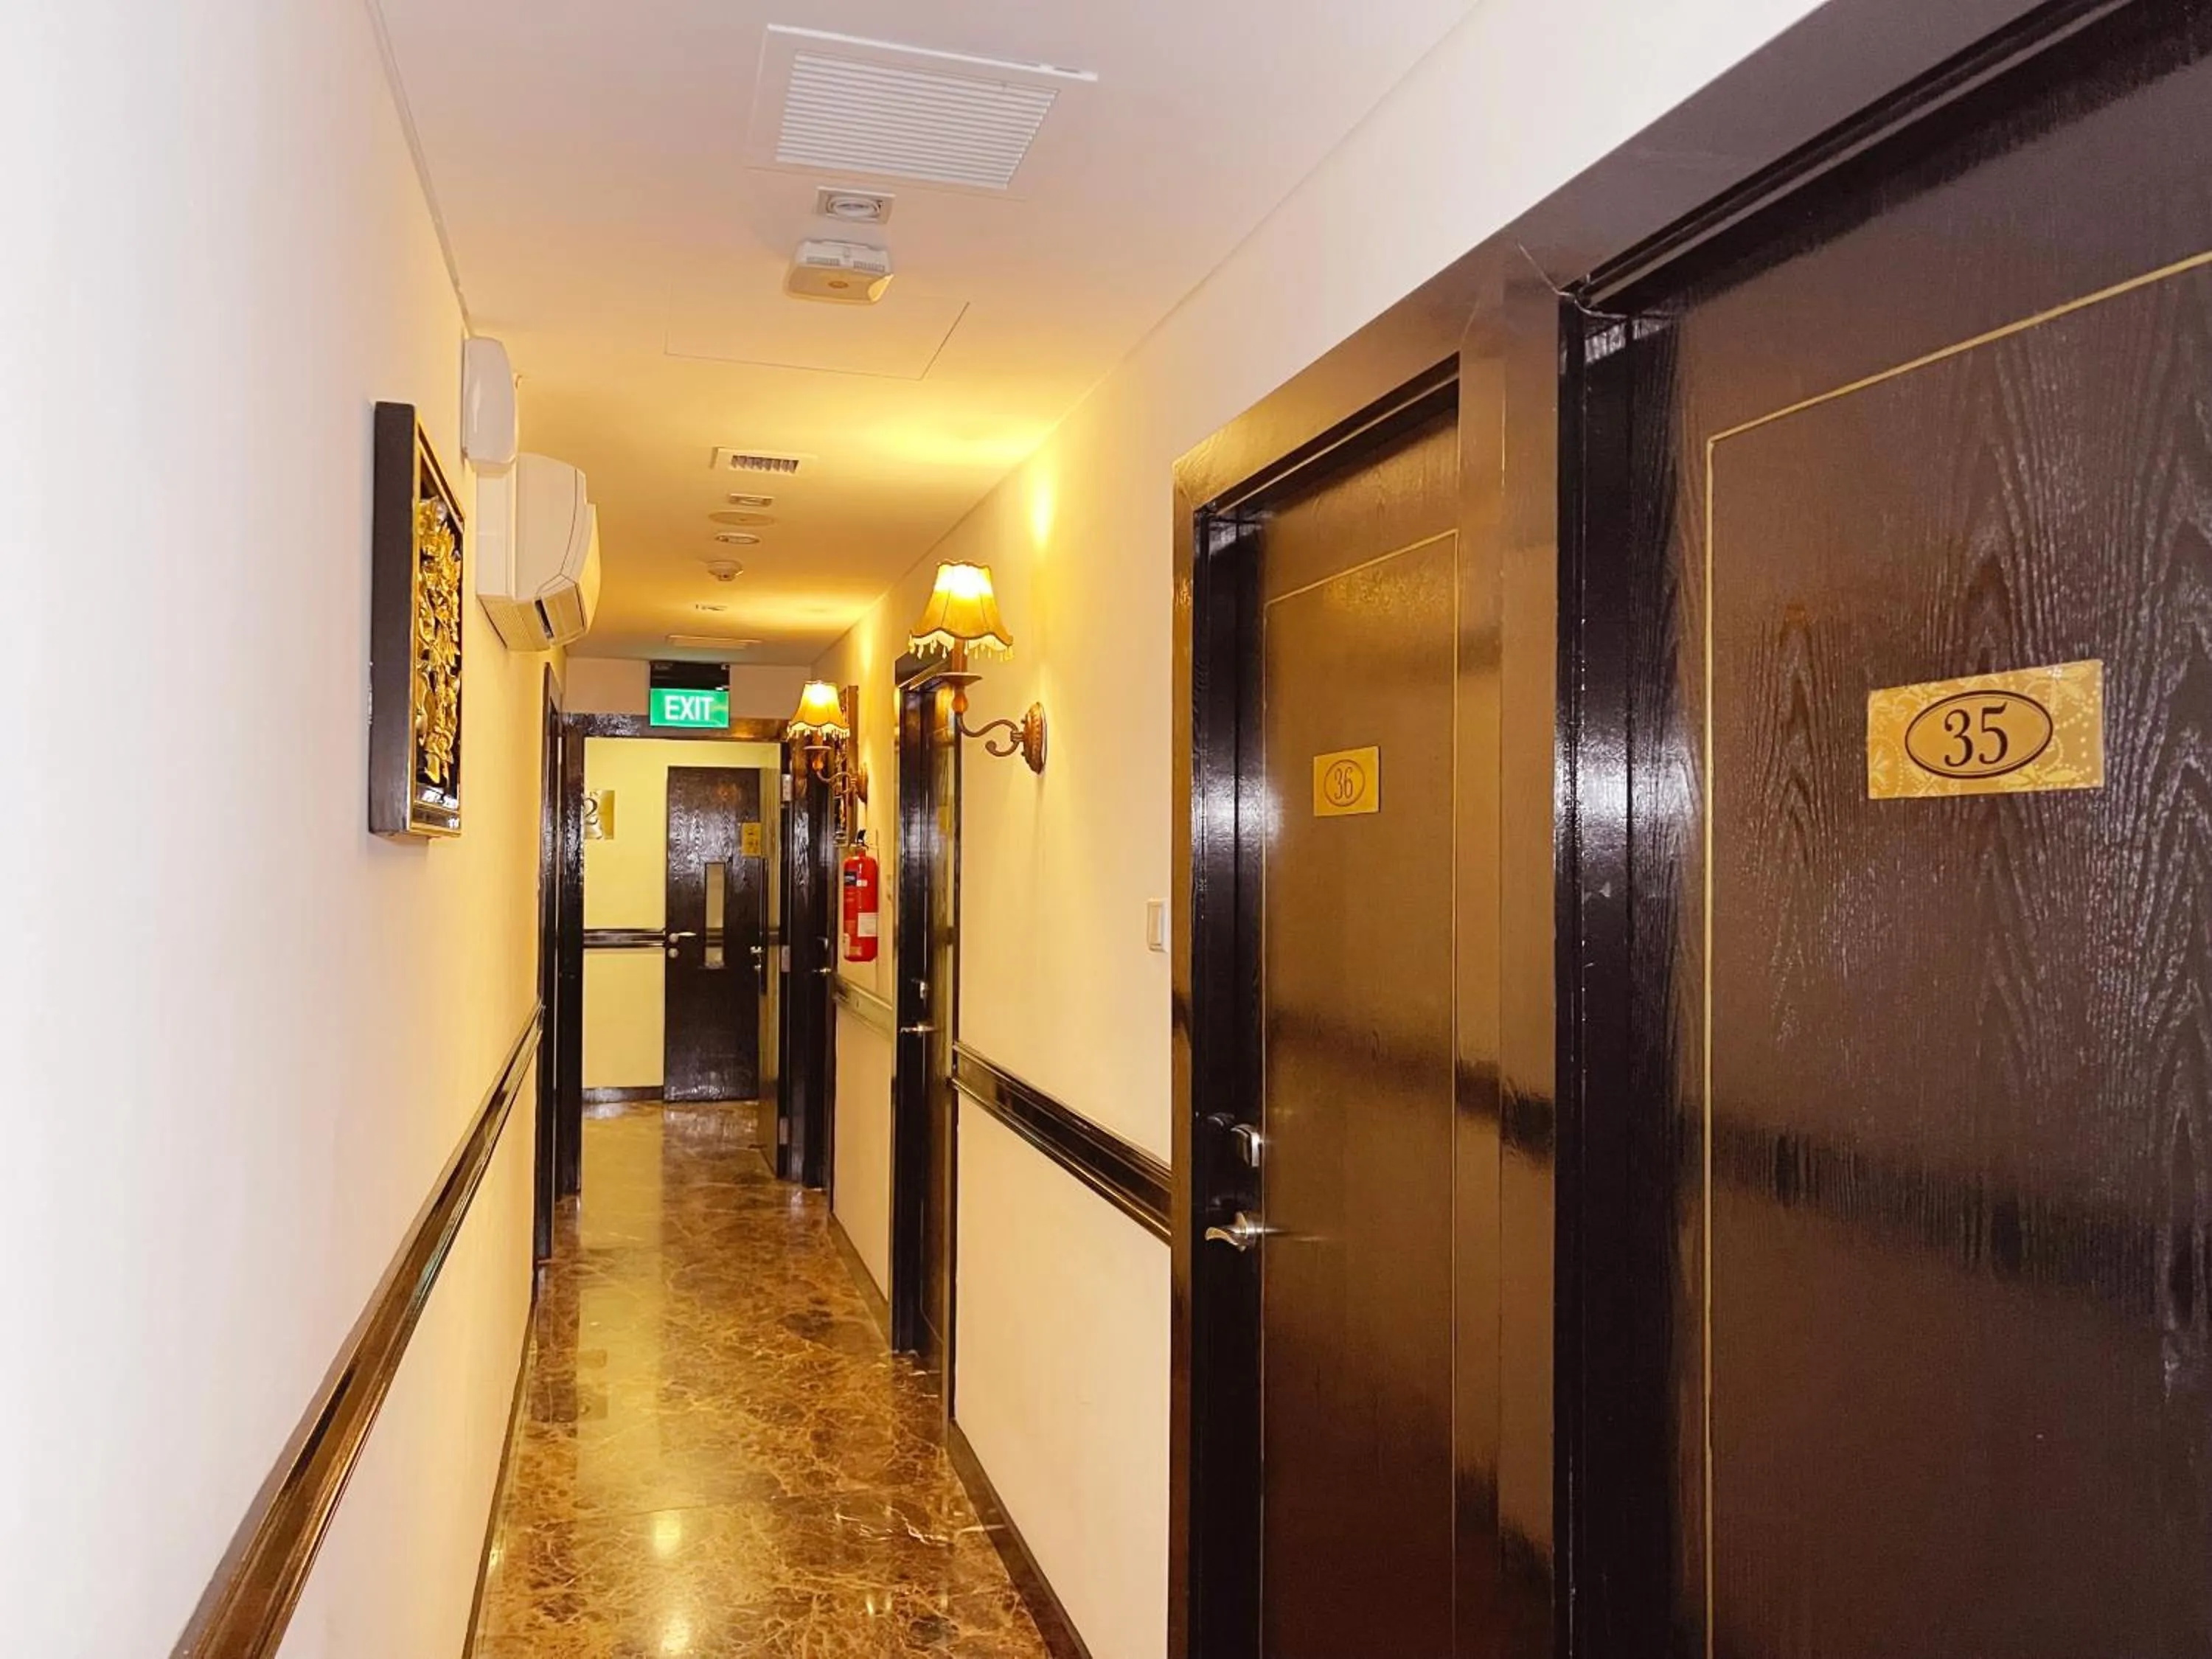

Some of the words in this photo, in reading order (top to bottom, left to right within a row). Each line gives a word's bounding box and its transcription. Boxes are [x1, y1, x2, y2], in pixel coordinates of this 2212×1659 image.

[664, 695, 714, 720] EXIT
[1944, 702, 2008, 767] 35
[1334, 766, 1353, 800] 36
